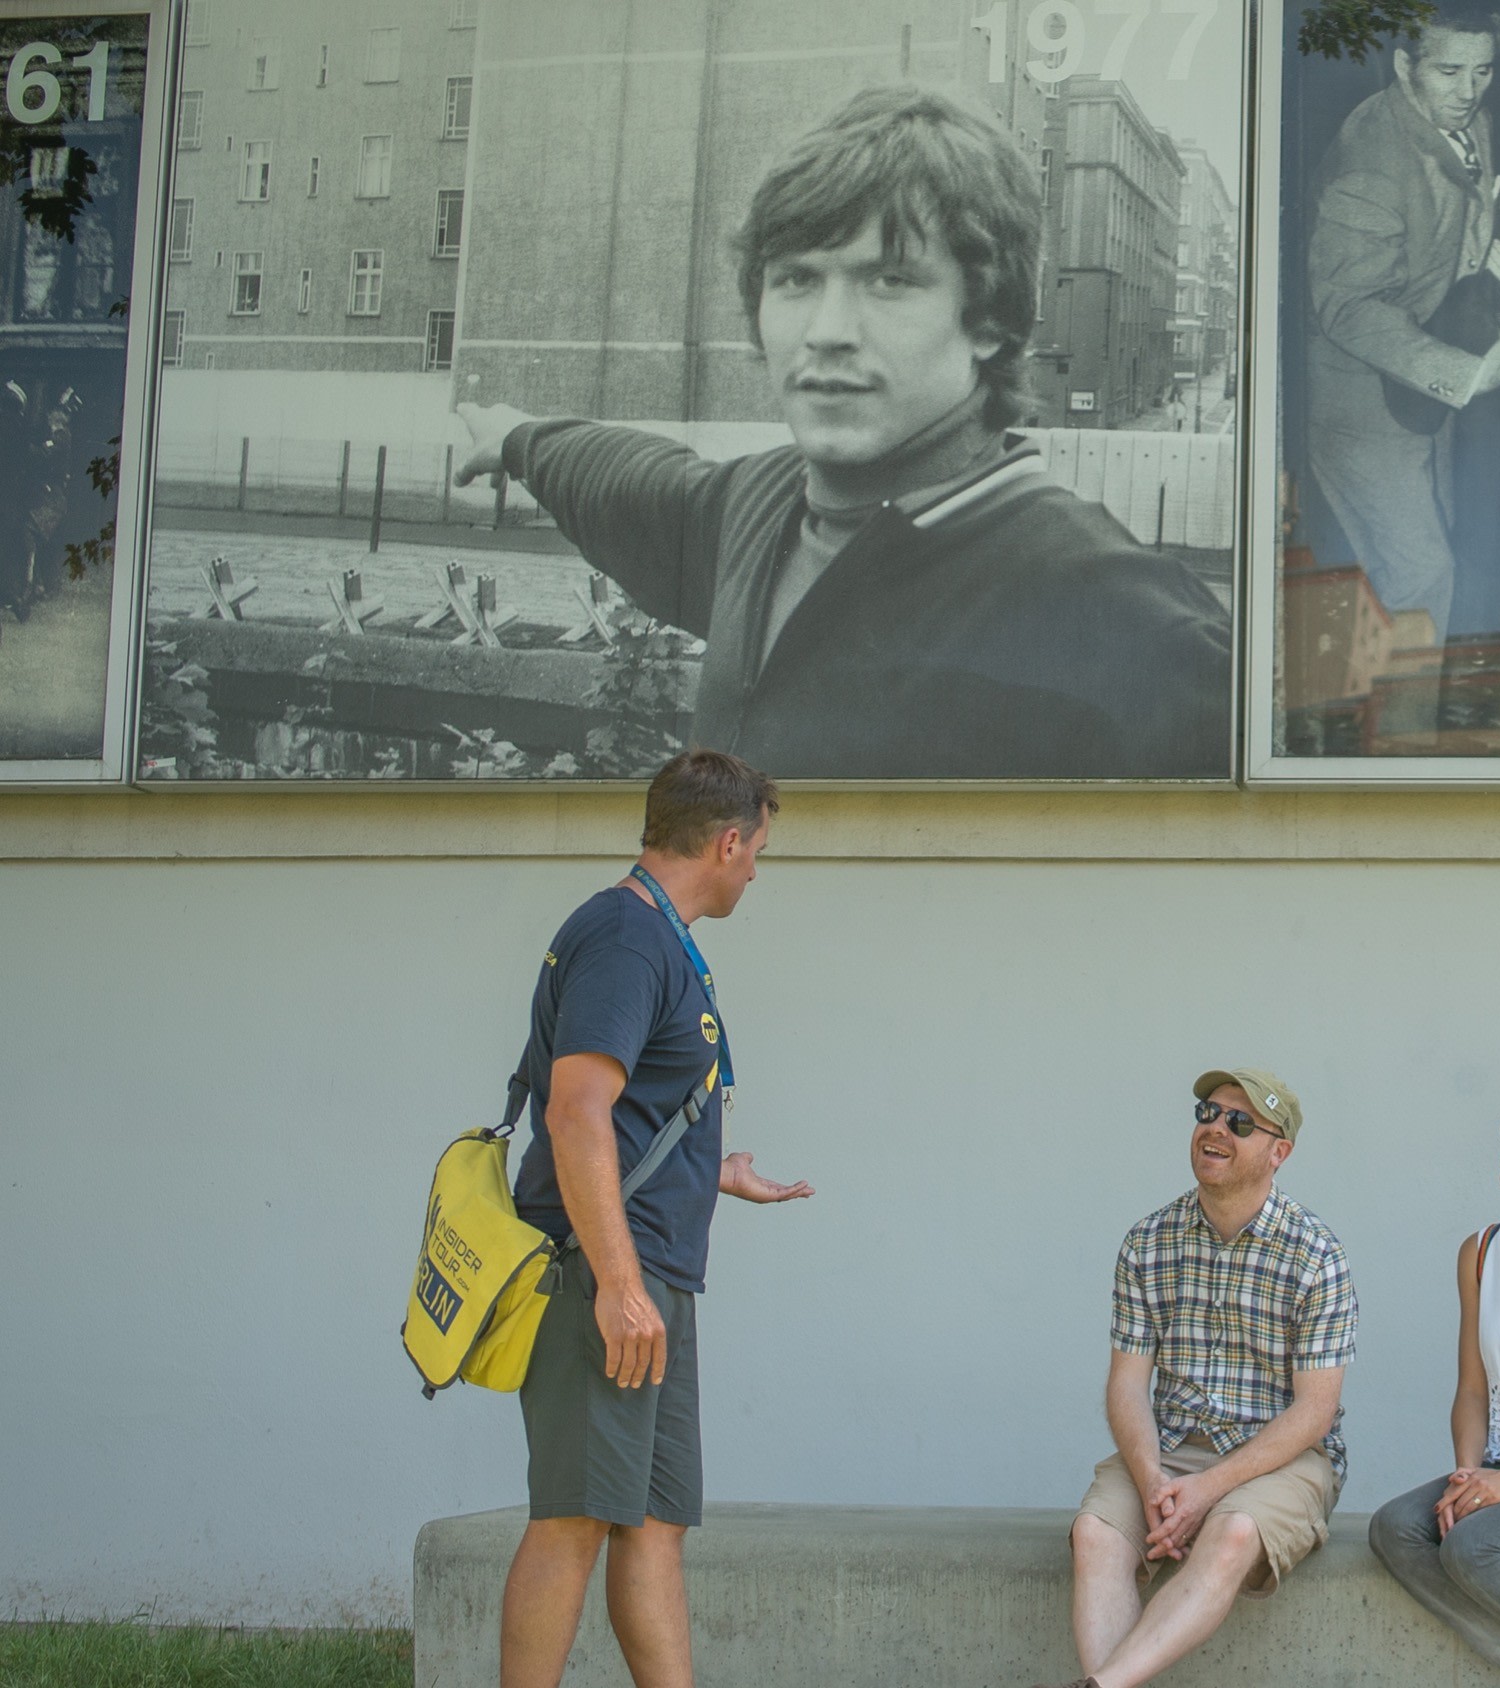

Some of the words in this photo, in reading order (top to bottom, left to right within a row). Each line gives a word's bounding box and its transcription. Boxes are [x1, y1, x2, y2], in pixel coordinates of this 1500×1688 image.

[6, 41, 109, 124] 61
[971, 0, 1218, 83] 1977
[438, 1217, 482, 1275] INSIDER
